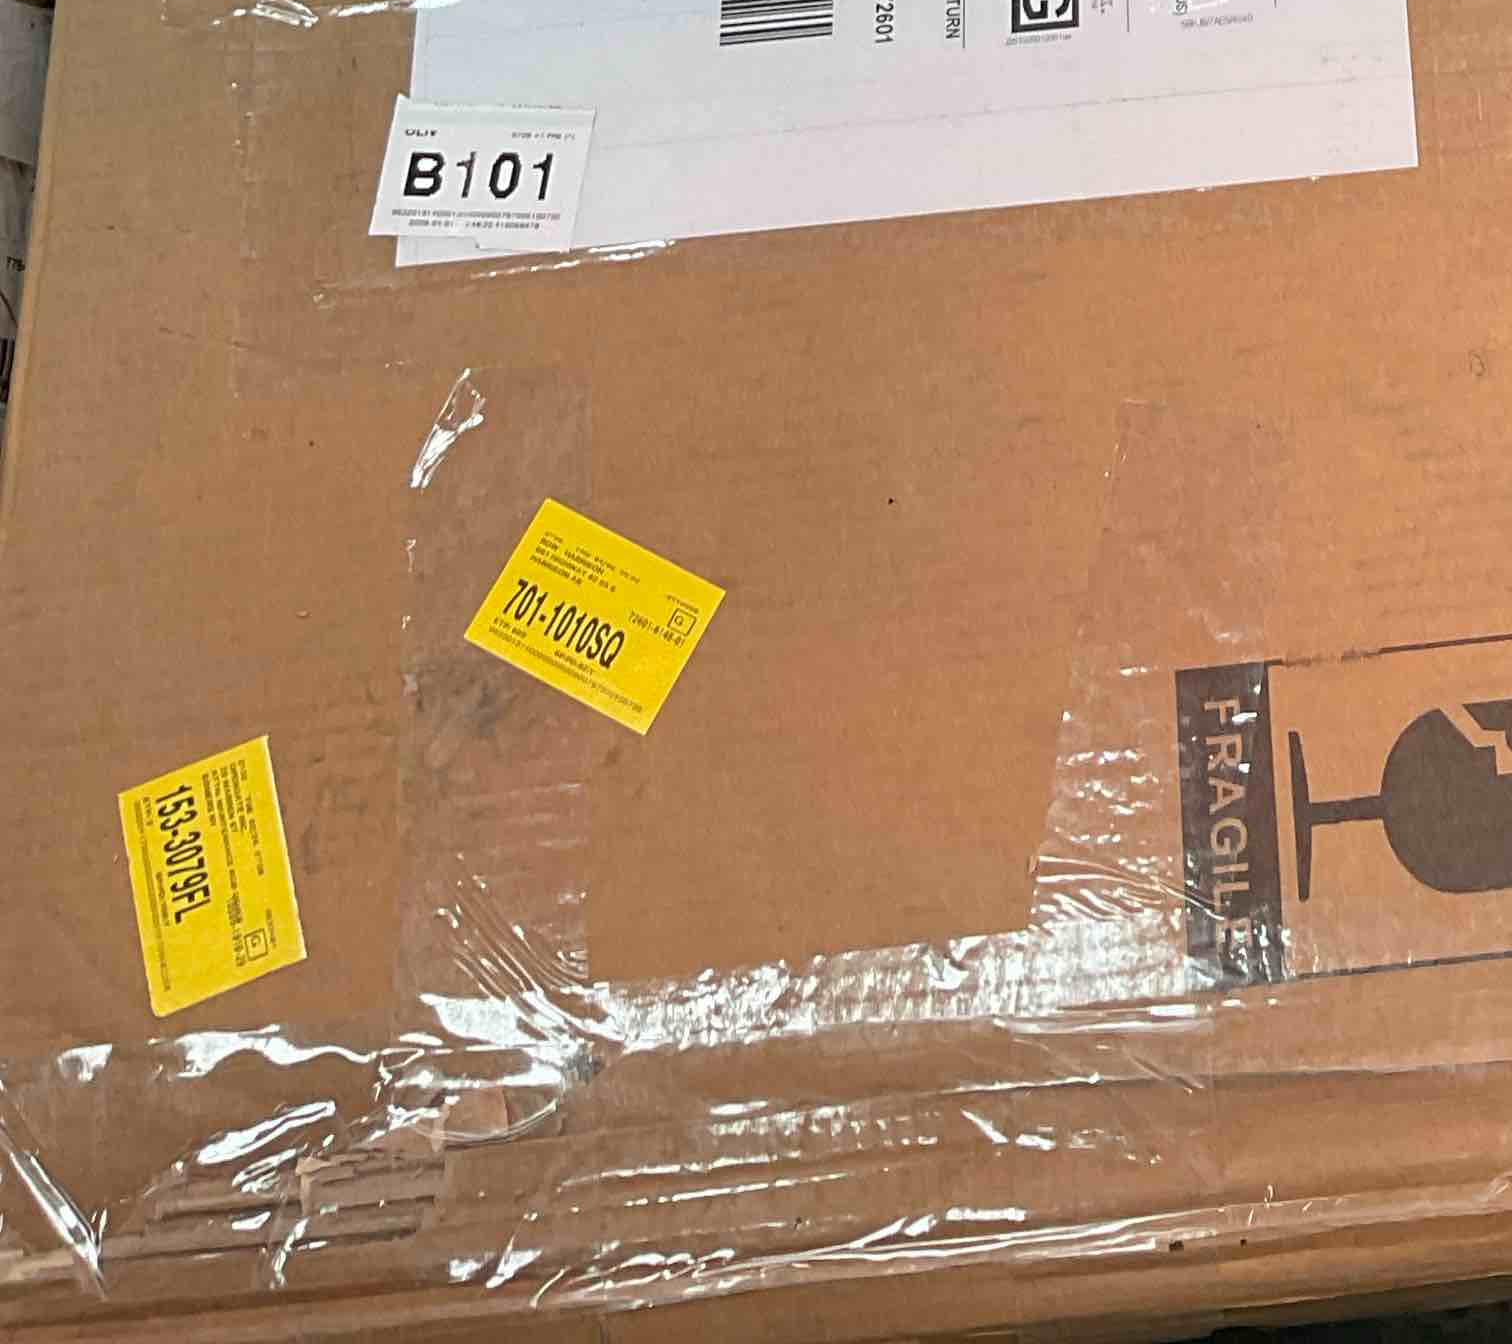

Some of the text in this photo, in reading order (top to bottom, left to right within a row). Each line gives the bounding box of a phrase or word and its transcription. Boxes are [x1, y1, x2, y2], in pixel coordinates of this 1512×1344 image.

[403, 151, 553, 200] B101
[502, 579, 625, 669] 701-1010SQ
[155, 784, 211, 924] 153-3079FL
[1204, 698, 1252, 944] FRAGILE
